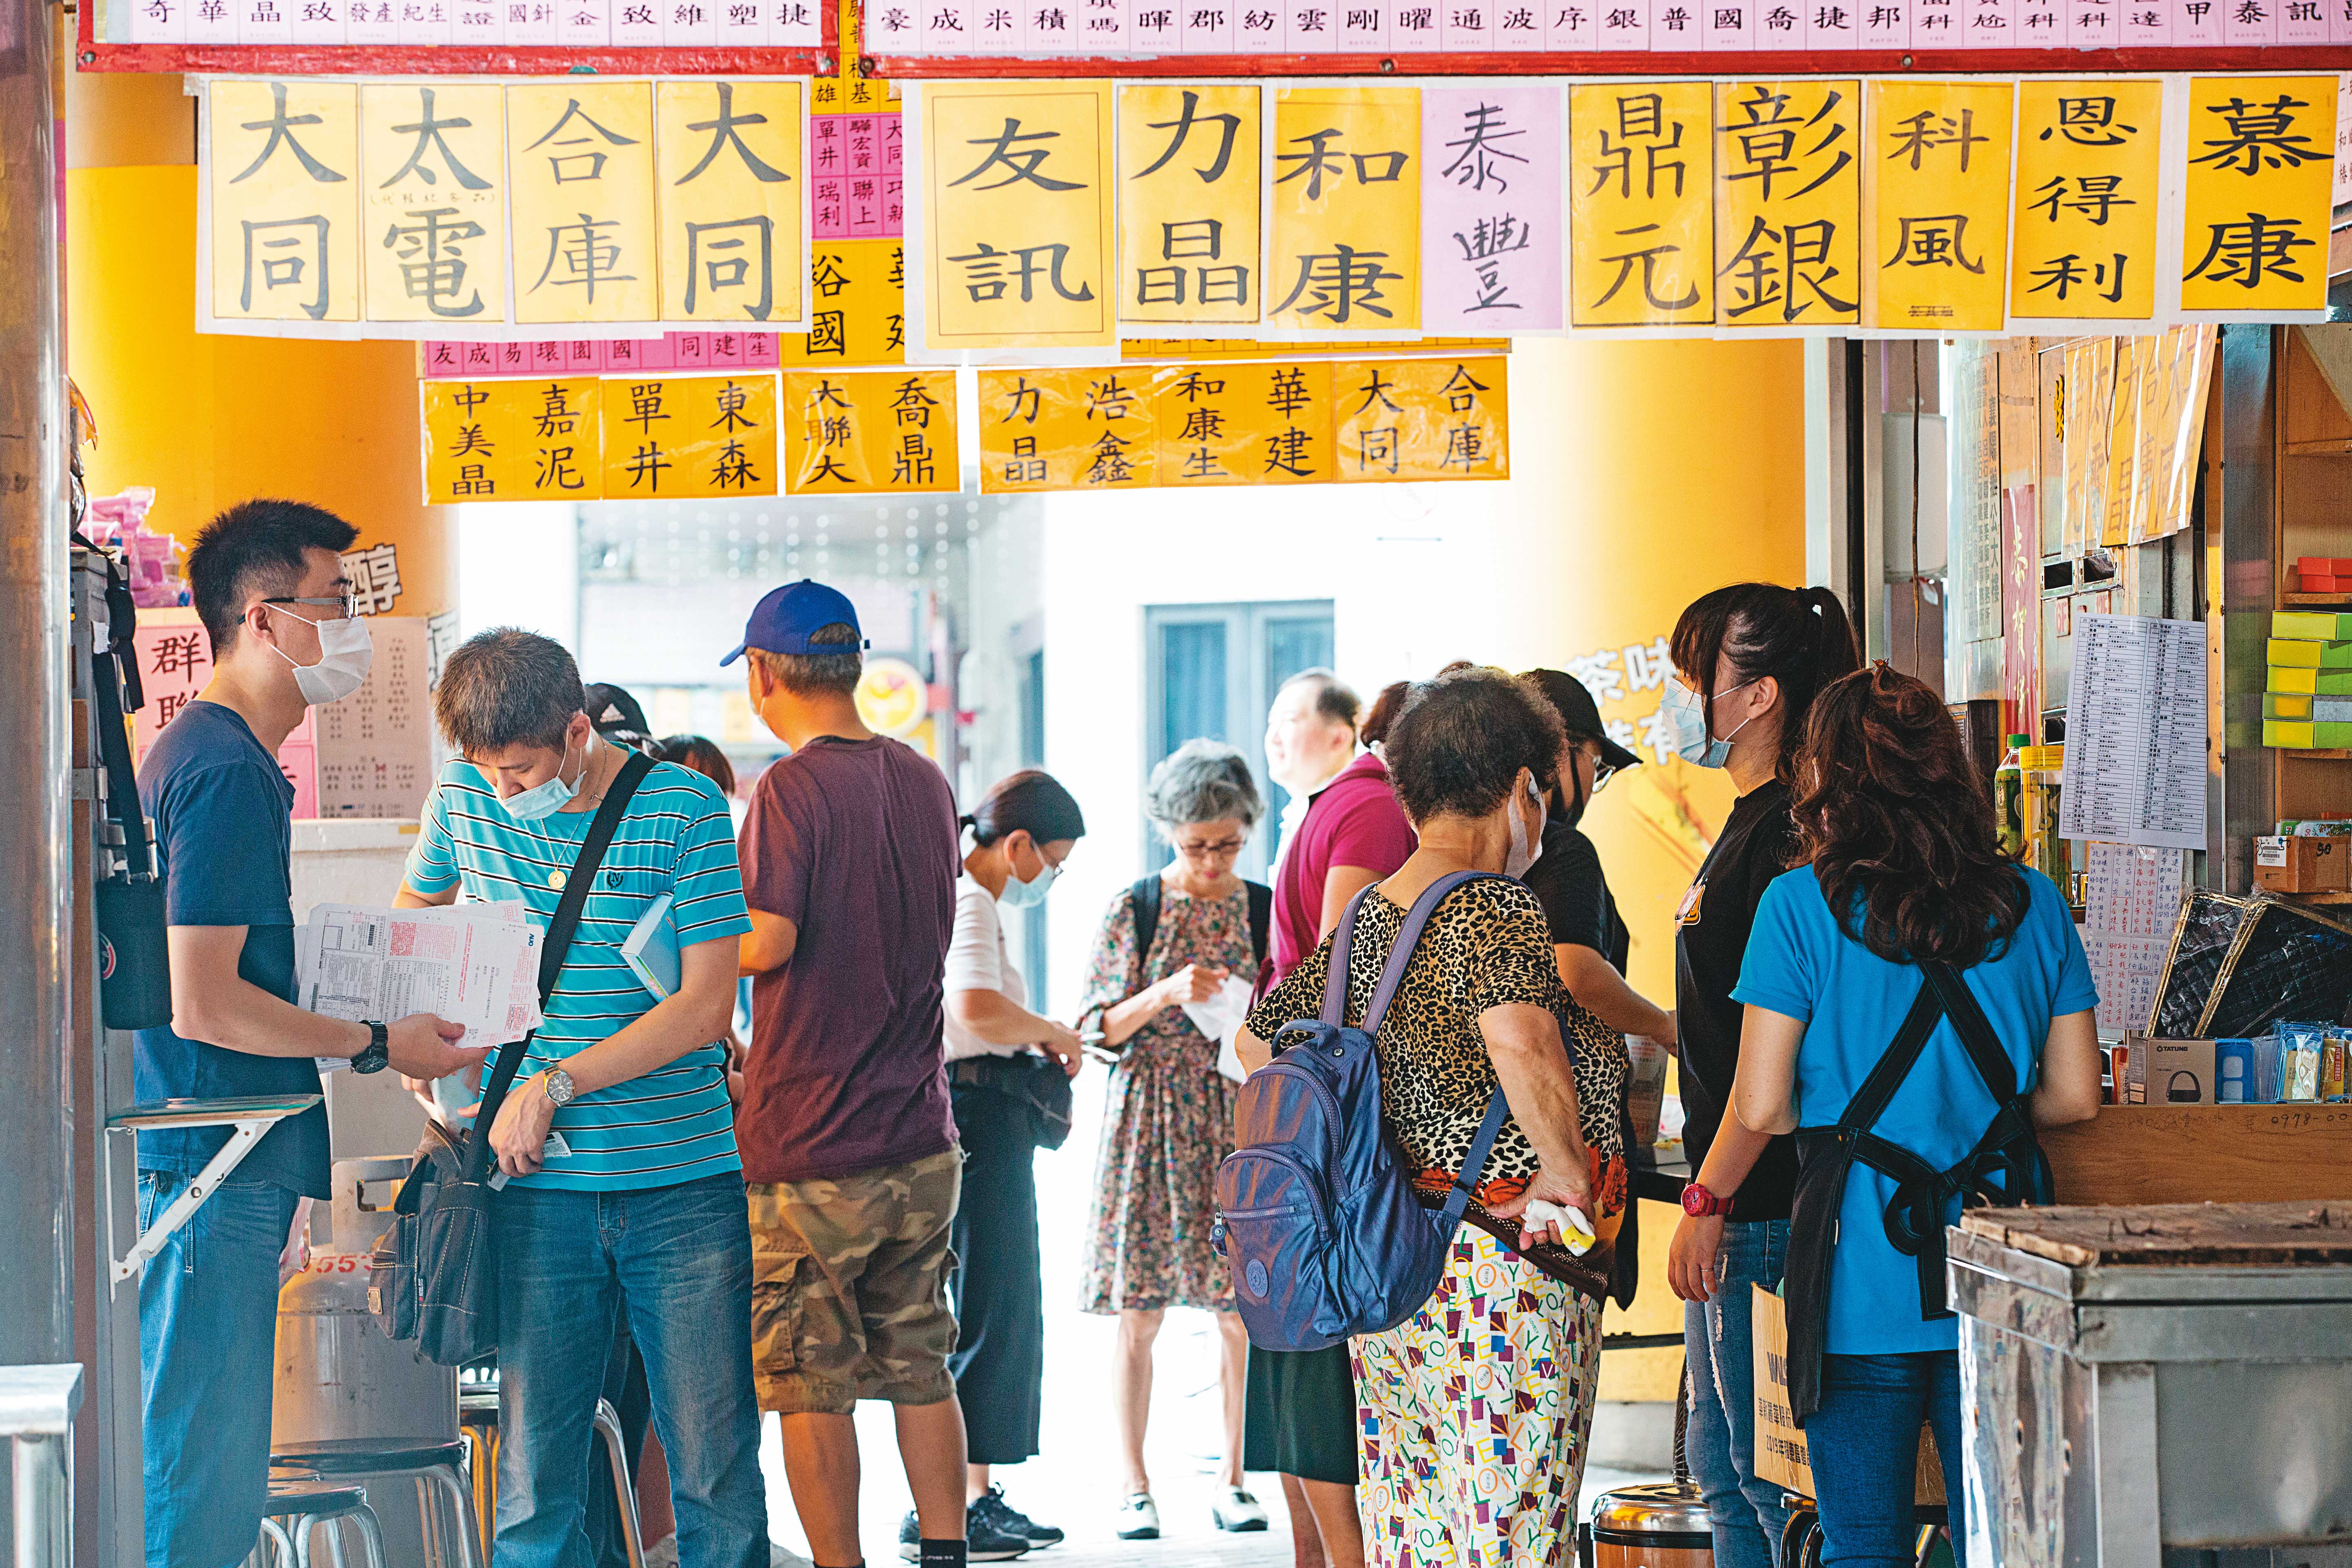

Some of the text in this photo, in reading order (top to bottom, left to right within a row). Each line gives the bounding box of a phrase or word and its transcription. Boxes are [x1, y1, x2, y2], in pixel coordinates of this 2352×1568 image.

[197, 0, 229, 23] 華
[250, 1, 281, 22] 晶
[301, 1, 338, 22] 致
[621, 3, 660, 25] 致
[674, 4, 708, 27] 維
[728, 3, 758, 26] 塑
[777, 4, 813, 25] 捷
[882, 8, 913, 31] 豪
[929, 9, 964, 31] 成
[984, 9, 1012, 31] 米
[1033, 8, 1068, 31] 積
[1138, 9, 1173, 31] 暉
[1189, 9, 1224, 31] 郡
[1243, 9, 1277, 31] 紡
[1297, 9, 1327, 31] 雲
[1347, 9, 1379, 31] 剛
[1399, 8, 1433, 30] 曜
[1450, 9, 1486, 31] 通
[1503, 8, 1538, 31] 波
[1554, 7, 1587, 30] 序
[1604, 8, 1642, 29] 銀
[1662, 8, 1692, 30] 普
[1715, 8, 1742, 29] 國
[1764, 7, 1799, 30] 喬
[1814, 7, 1851, 30] 捷
[1867, 7, 1900, 29] 邦
[2185, 2, 2211, 25] 甲
[2232, 2, 2269, 24] 泰
[2285, 2, 2323, 21] 訊
[817, 120, 838, 169] 單井
[1129, 91, 1250, 306] 力晶
[1882, 108, 1989, 274] 科風
[2027, 96, 2138, 303] 恩得利
[2182, 94, 2335, 289] 慕康
[229, 82, 347, 321] 大同
[379, 87, 493, 317] 太電
[521, 98, 641, 305] 合庫
[674, 82, 791, 321] 大同
[818, 180, 840, 226] 瑞利
[853, 180, 876, 225] 聯上
[946, 117, 1095, 303] 友訊
[1267, 128, 1410, 323] 和康
[1441, 101, 1529, 314] 泰豐
[1586, 93, 1701, 310] 鼎元
[1715, 86, 1858, 322] 彰銀
[468, 342, 490, 364] 成
[682, 337, 700, 357] 同
[713, 336, 736, 357] 建
[449, 385, 495, 495] 中美晶
[533, 383, 585, 491] 嘉泥
[623, 382, 673, 493] 單井
[709, 380, 761, 491] 東森
[804, 380, 857, 484] 大聯大
[889, 377, 939, 484] 喬鼎
[1001, 376, 1047, 482] 力晶
[1085, 374, 1135, 484] 浩鑫
[1176, 372, 1228, 478] 和康生
[1264, 367, 1316, 477] 華建
[1353, 369, 1404, 474] 大同
[1437, 364, 1490, 474] 合庫
[2316, 842, 2332, 857] 50
[1477, 1370, 1490, 1385] TRIPE
